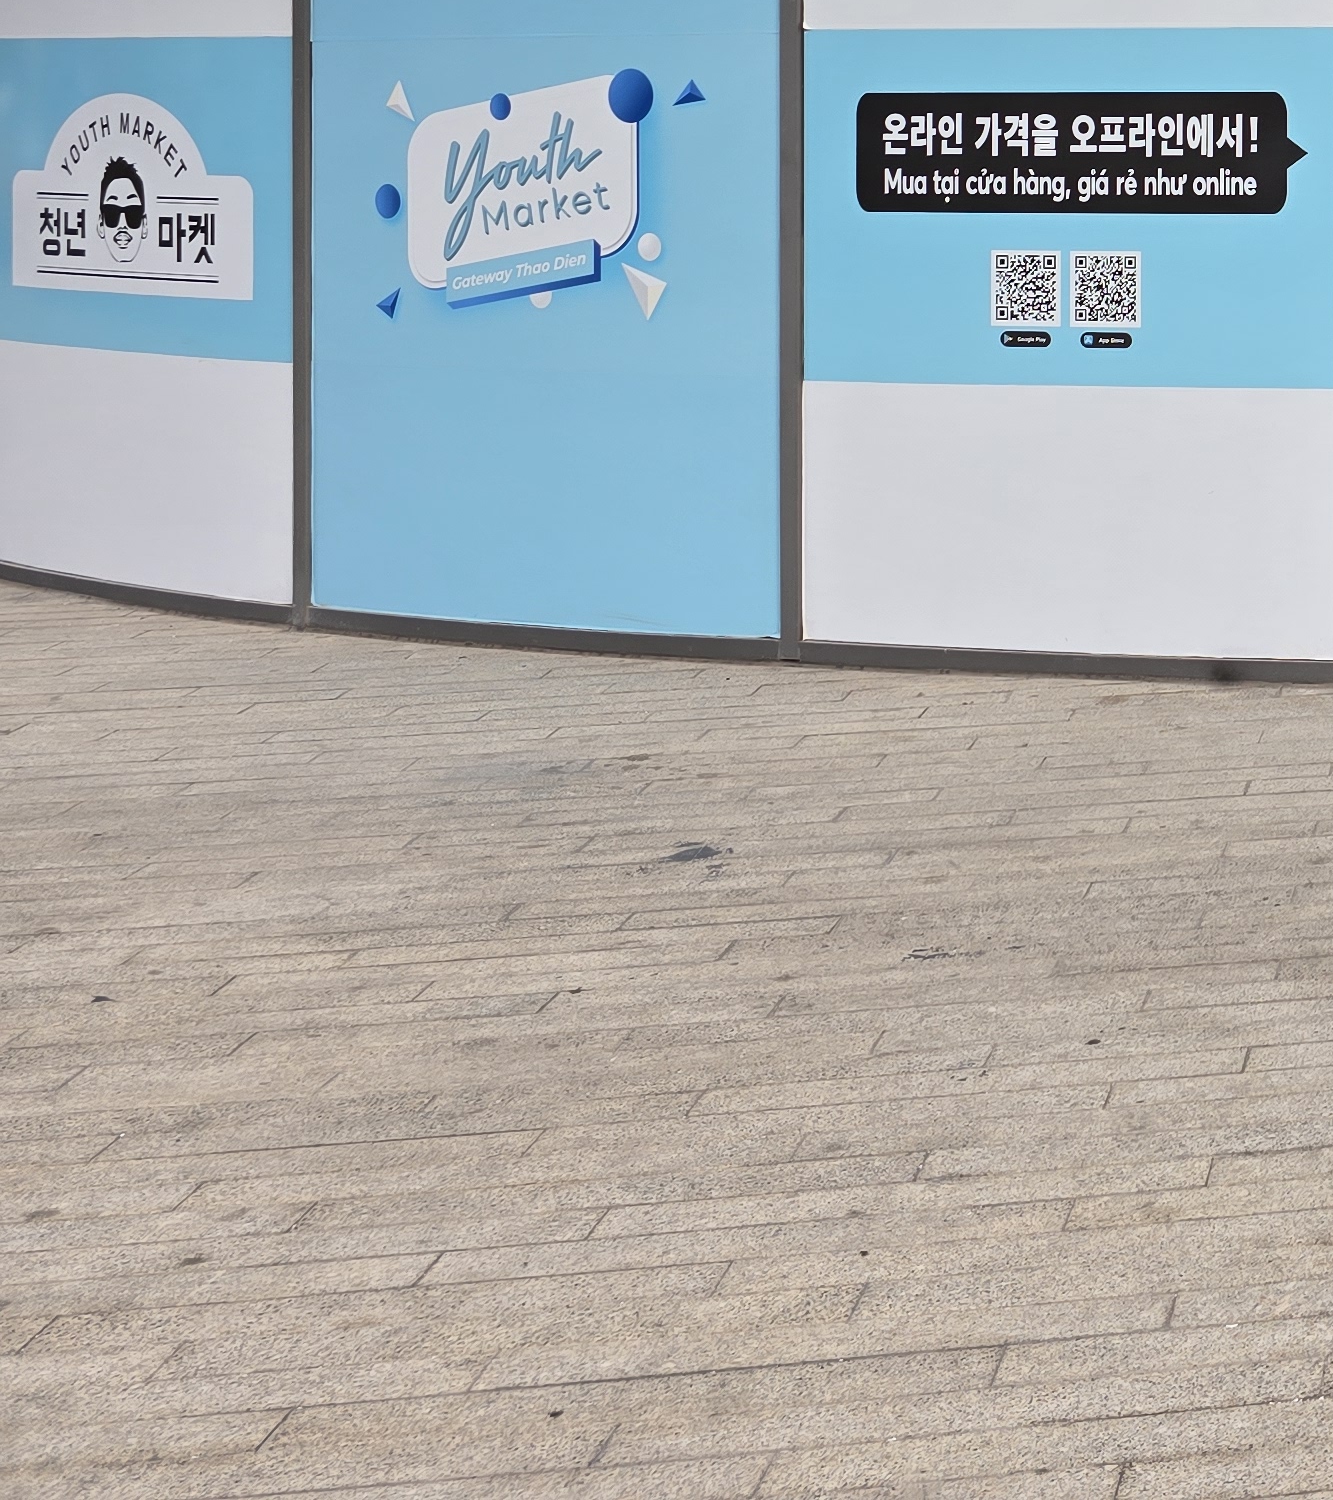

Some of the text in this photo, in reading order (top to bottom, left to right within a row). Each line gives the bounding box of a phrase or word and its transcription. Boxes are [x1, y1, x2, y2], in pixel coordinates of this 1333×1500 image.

[60, 112, 189, 180] YOUTH MARKET
[883, 113, 1259, 157] 온라인 가격을 오프라인에서!
[443, 111, 602, 262] Youth
[481, 180, 611, 235] Market
[884, 168, 1257, 203] Mua tại cửa hàng, giá rẻ như online
[39, 206, 217, 264] 청년 마켓
[451, 252, 586, 291] Gateway Thao Dien
